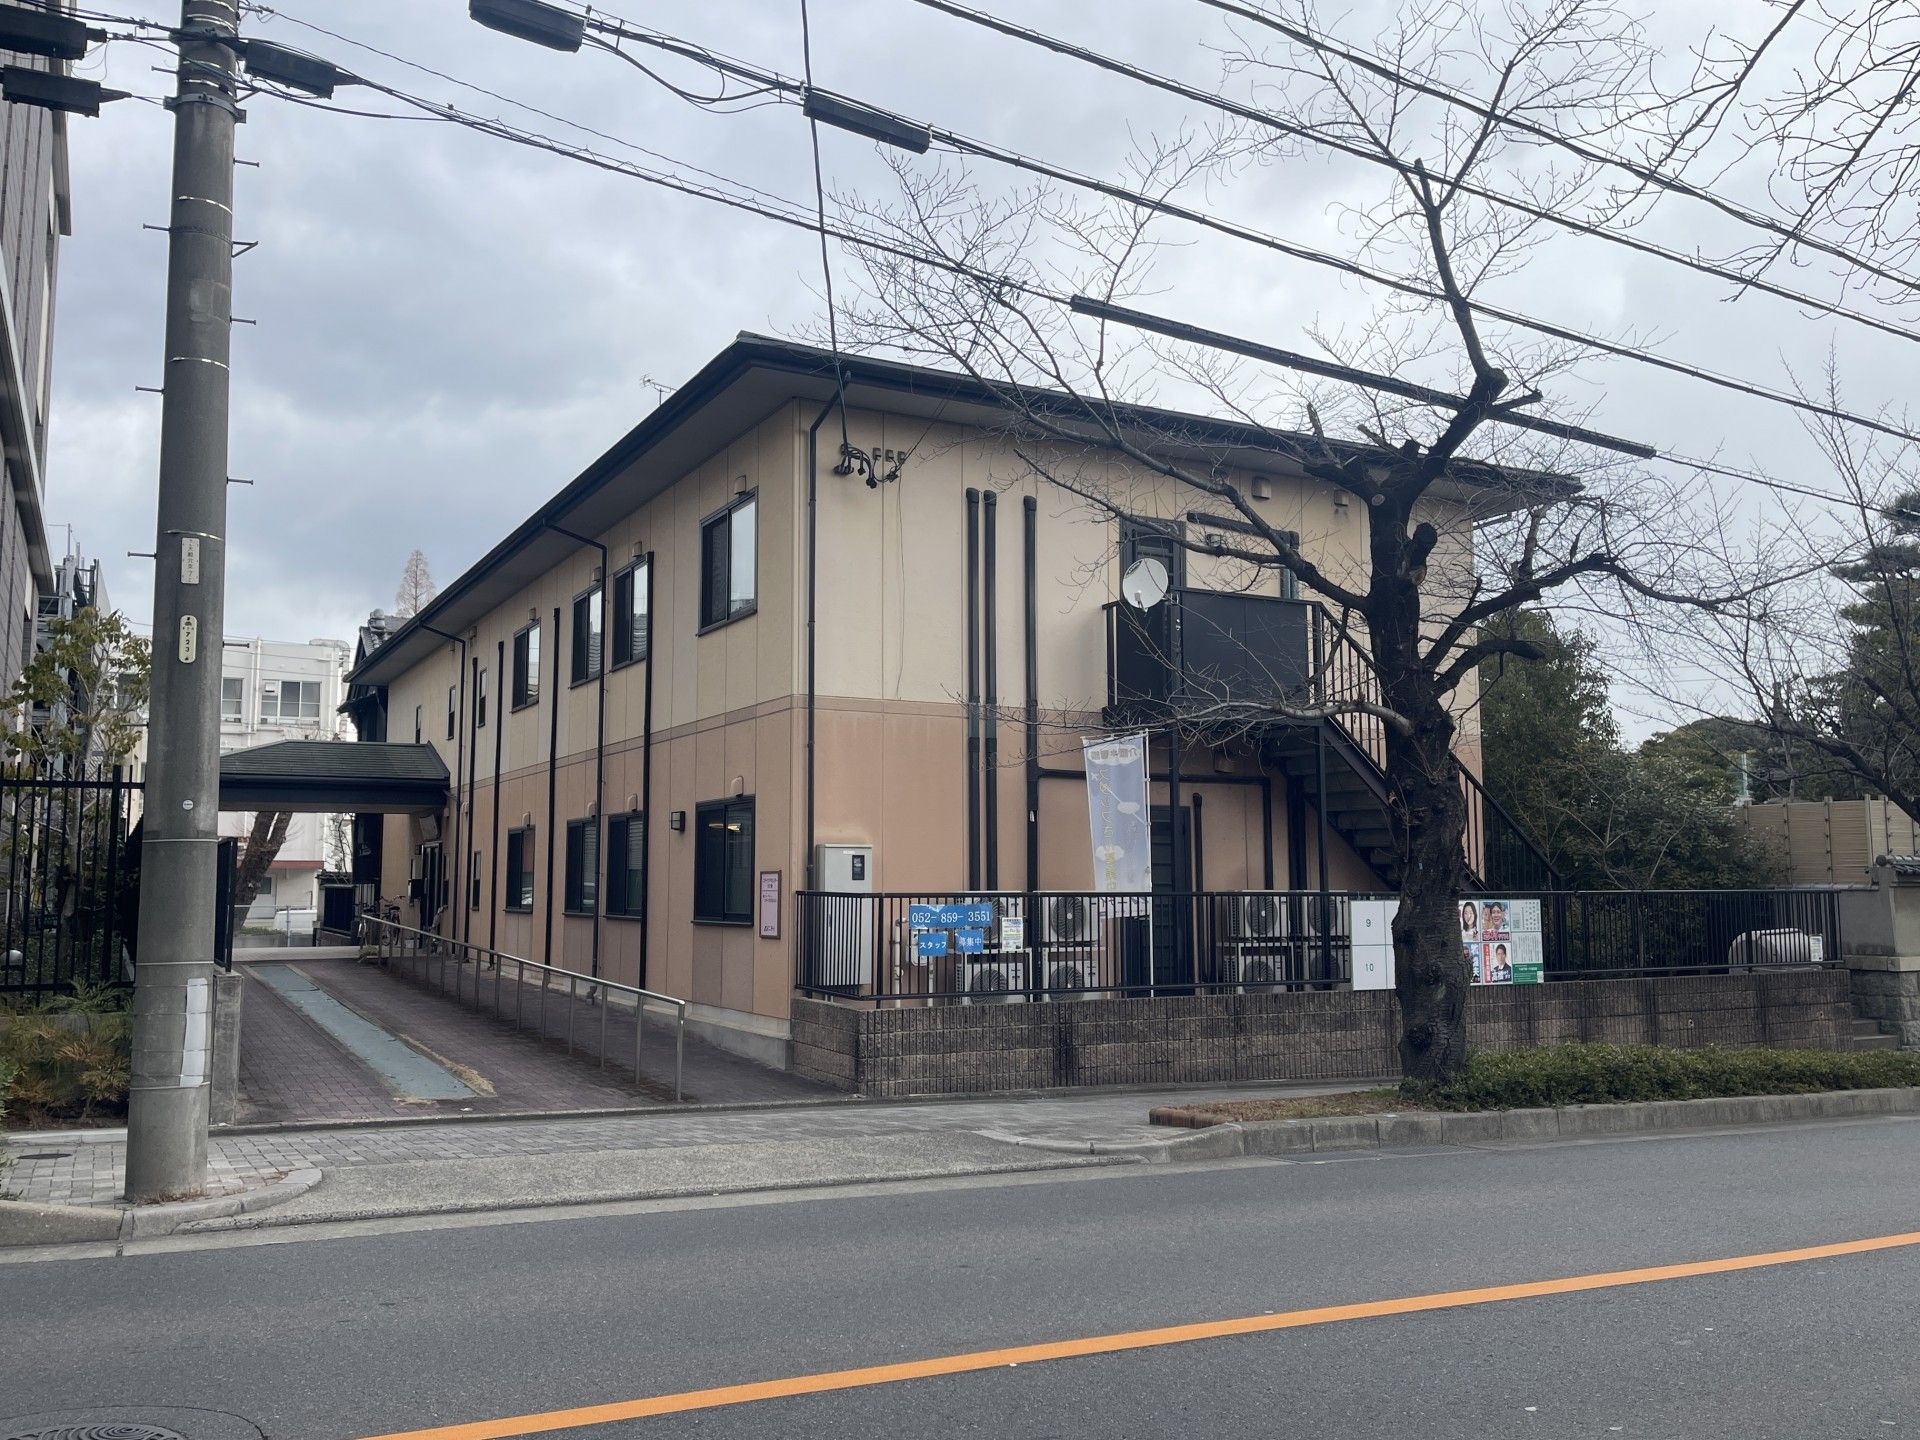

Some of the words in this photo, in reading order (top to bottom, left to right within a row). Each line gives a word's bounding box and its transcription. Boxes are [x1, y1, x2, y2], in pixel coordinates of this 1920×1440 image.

[1365, 918, 1371, 928] 9
[919, 941, 947, 949] スタッフ
[958, 937, 982, 947] 募集中
[1365, 963, 1374, 972] 10
